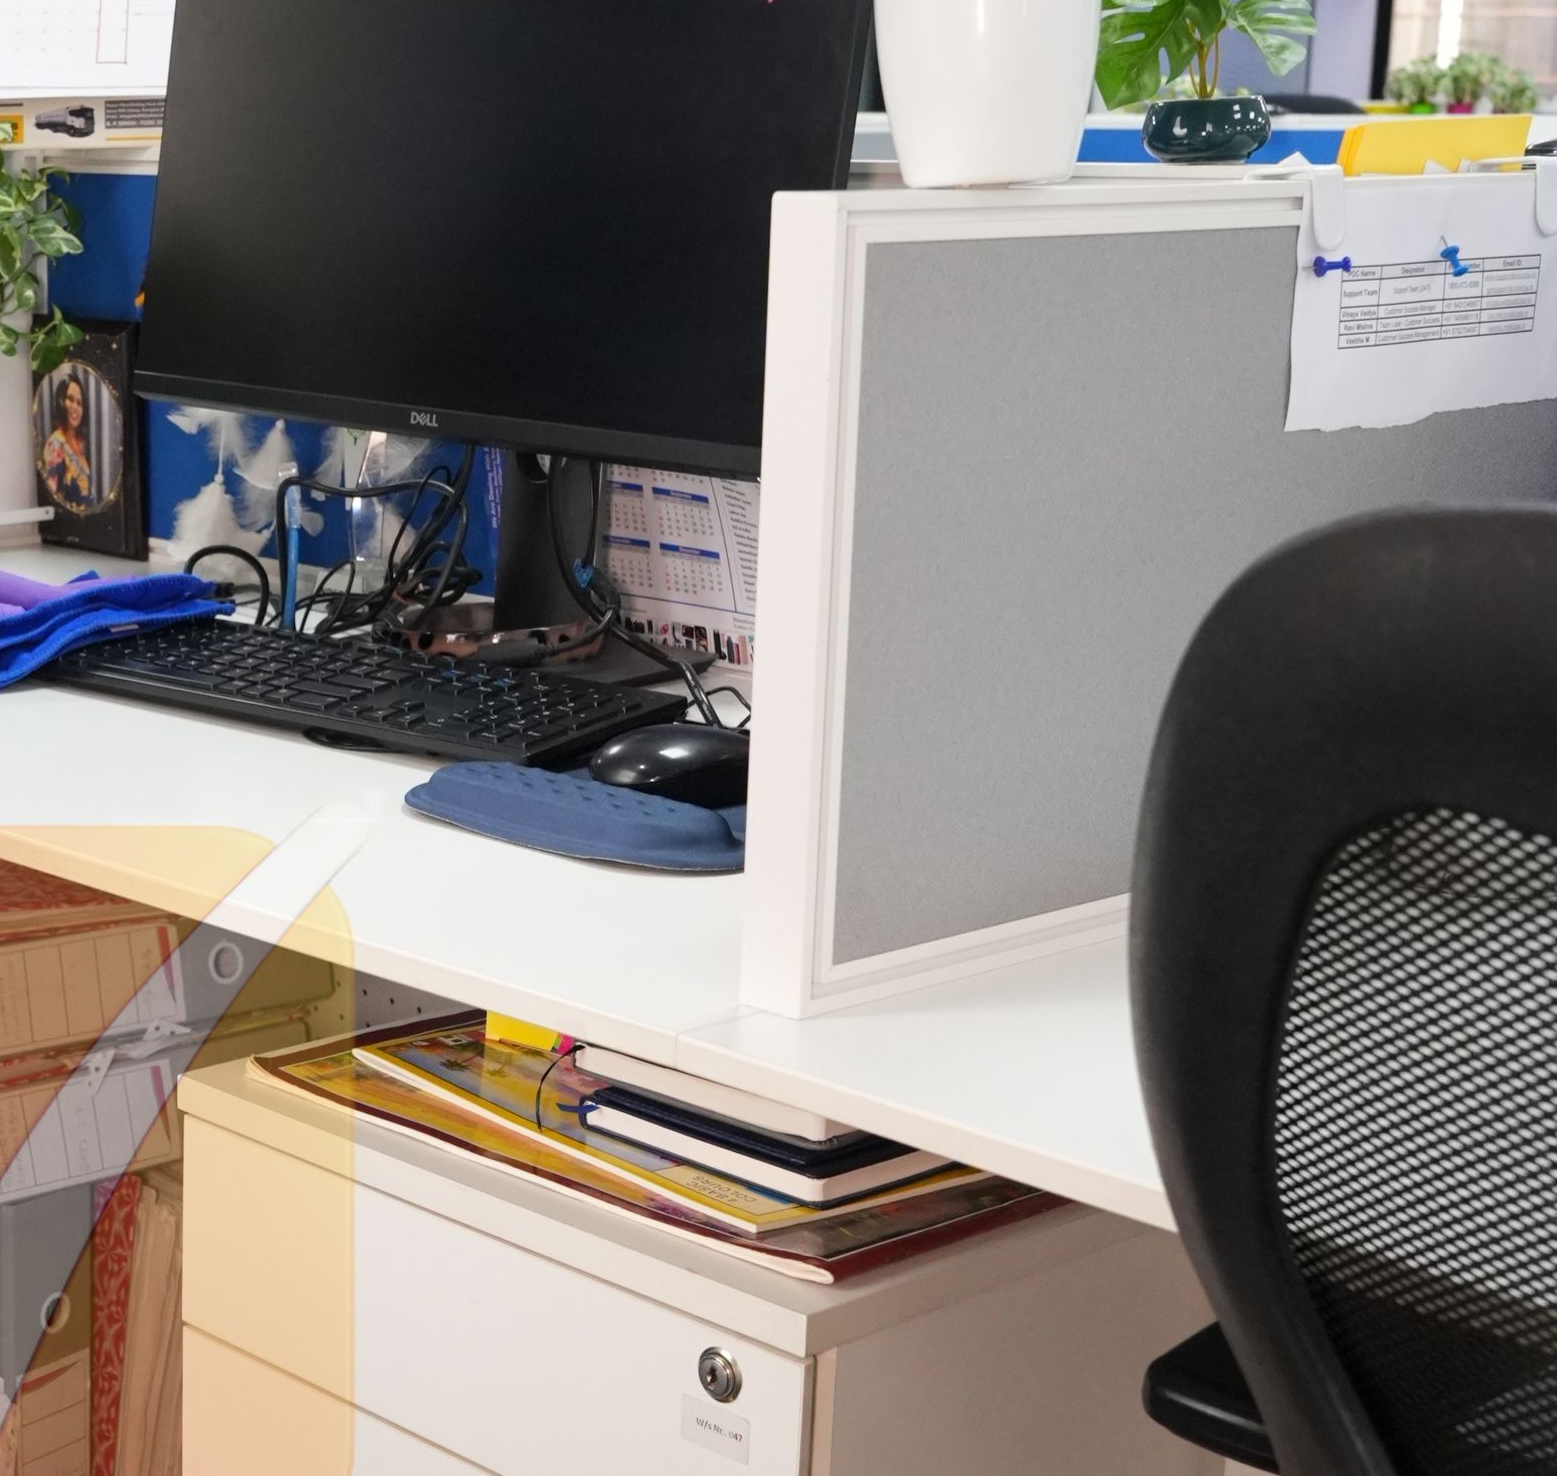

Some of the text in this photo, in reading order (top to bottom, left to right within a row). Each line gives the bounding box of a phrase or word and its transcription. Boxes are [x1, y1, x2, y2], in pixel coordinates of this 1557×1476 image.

[1343, 288, 1378, 299] Support Team
[410, 411, 439, 427] DELL
[686, 1181, 729, 1199] BASIC
[692, 1175, 757, 1203] COLOURS
[728, 1431, 743, 1442] 047
